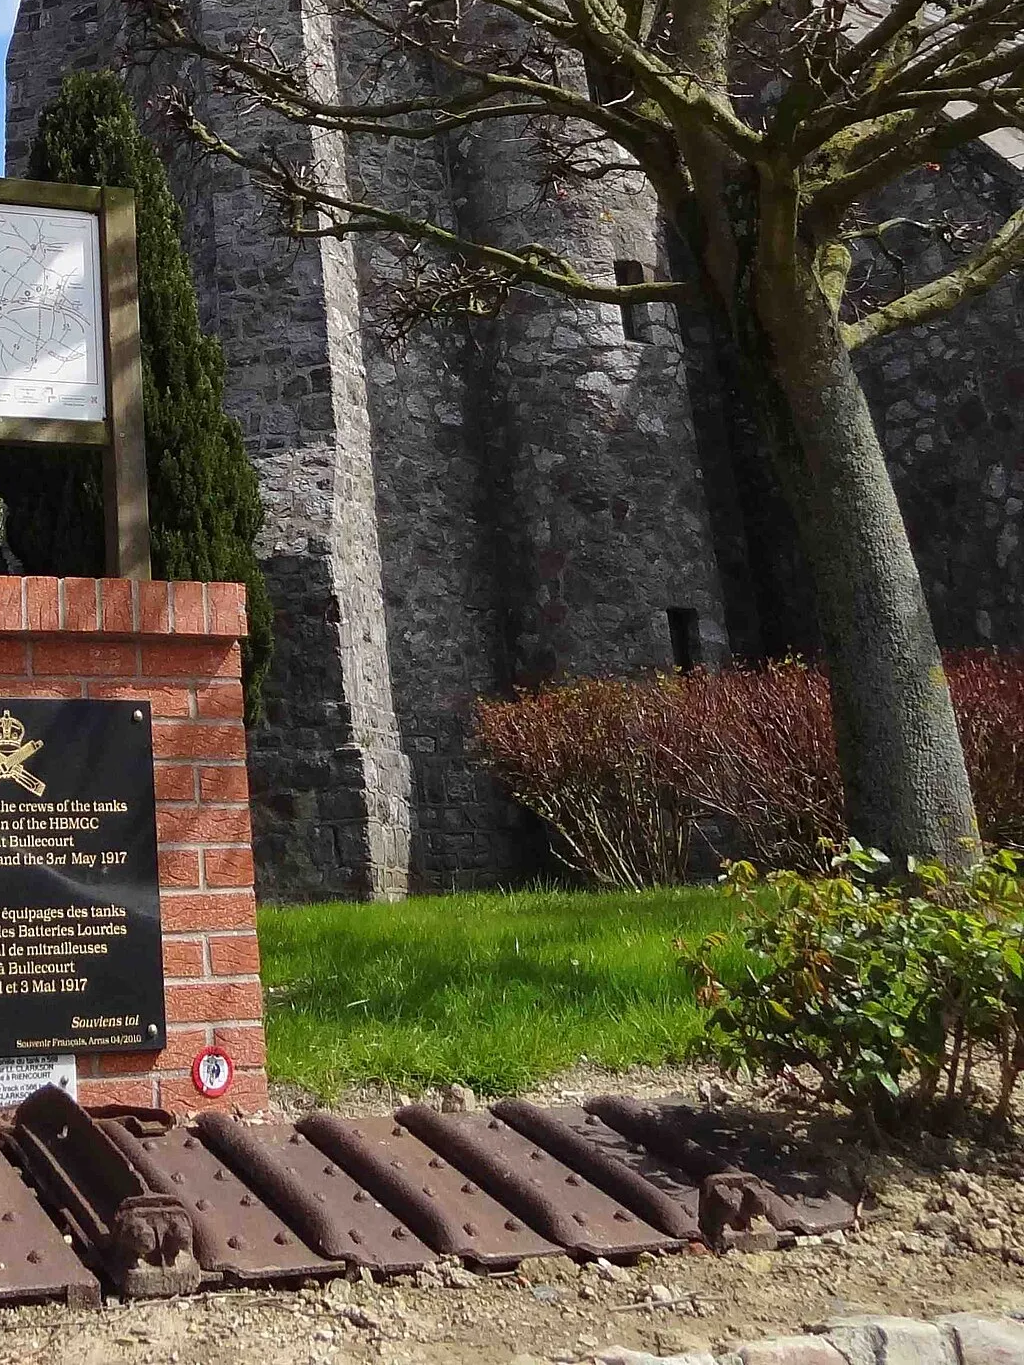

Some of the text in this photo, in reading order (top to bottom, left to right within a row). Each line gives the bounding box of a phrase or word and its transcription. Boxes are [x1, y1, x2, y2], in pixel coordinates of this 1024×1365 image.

[18, 802, 54, 812] crews
[56, 799, 70, 812] of
[71, 800, 90, 812] the
[93, 800, 128, 812] tanks
[12, 817, 26, 830] of
[27, 817, 47, 830] the
[49, 817, 100, 830] HBMGC
[10, 835, 74, 848] Bullecourt
[24, 852, 44, 865] the
[71, 853, 96, 867] May
[100, 852, 128, 864] 1917
[2, 907, 64, 922] équipages
[66, 906, 88, 918] des
[90, 904, 126, 918] tanks
[18, 924, 74, 938] Batteries
[77, 923, 127, 936] Lourdes
[8, 944, 24, 956] de
[26, 942, 108, 956] mitrailleuses
[8, 961, 76, 975] Bullecourt
[6, 982, 18, 994] et
[20, 980, 29, 993] 3
[32, 979, 56, 993] Mai
[60, 978, 88, 992] 1917
[71, 1014, 140, 1029] Souviens toi
[16, 1038, 51, 1048] Souvenir
[110, 1034, 142, 1046] 04/2010
[16, 1064, 54, 1072] CLARKSON
[11, 1072, 52, 1081] RIENCOURT
